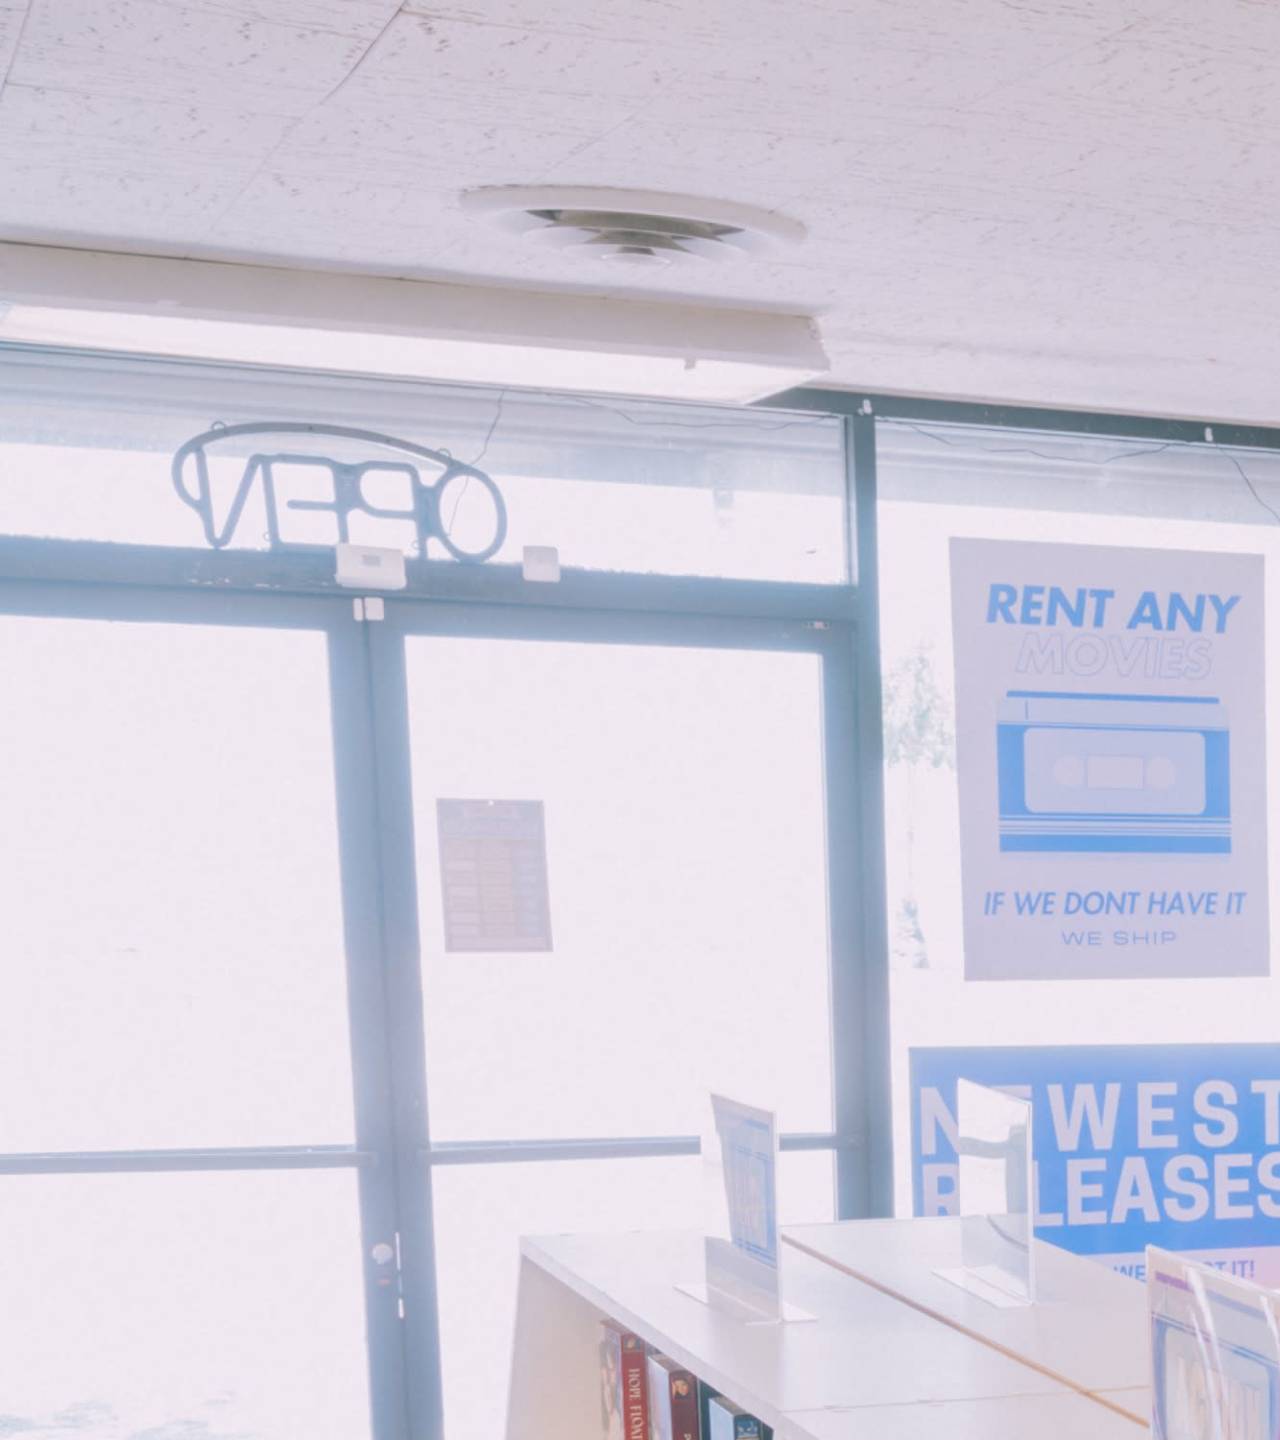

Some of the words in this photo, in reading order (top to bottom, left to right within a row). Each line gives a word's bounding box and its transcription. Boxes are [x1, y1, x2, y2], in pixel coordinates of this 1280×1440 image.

[986, 584, 1115, 629] RENT
[1127, 591, 1242, 635] ANY
[1014, 631, 1214, 681] MOVIES
[983, 890, 1005, 916] IF
[1012, 891, 1057, 916] WE
[1063, 891, 1142, 917] DONT
[1146, 892, 1222, 917] HAVE
[1225, 892, 1247, 916] IT
[1061, 930, 1103, 946] WE
[1113, 931, 1177, 947] SHIP
[629, 1368, 643, 1401] HOPE
